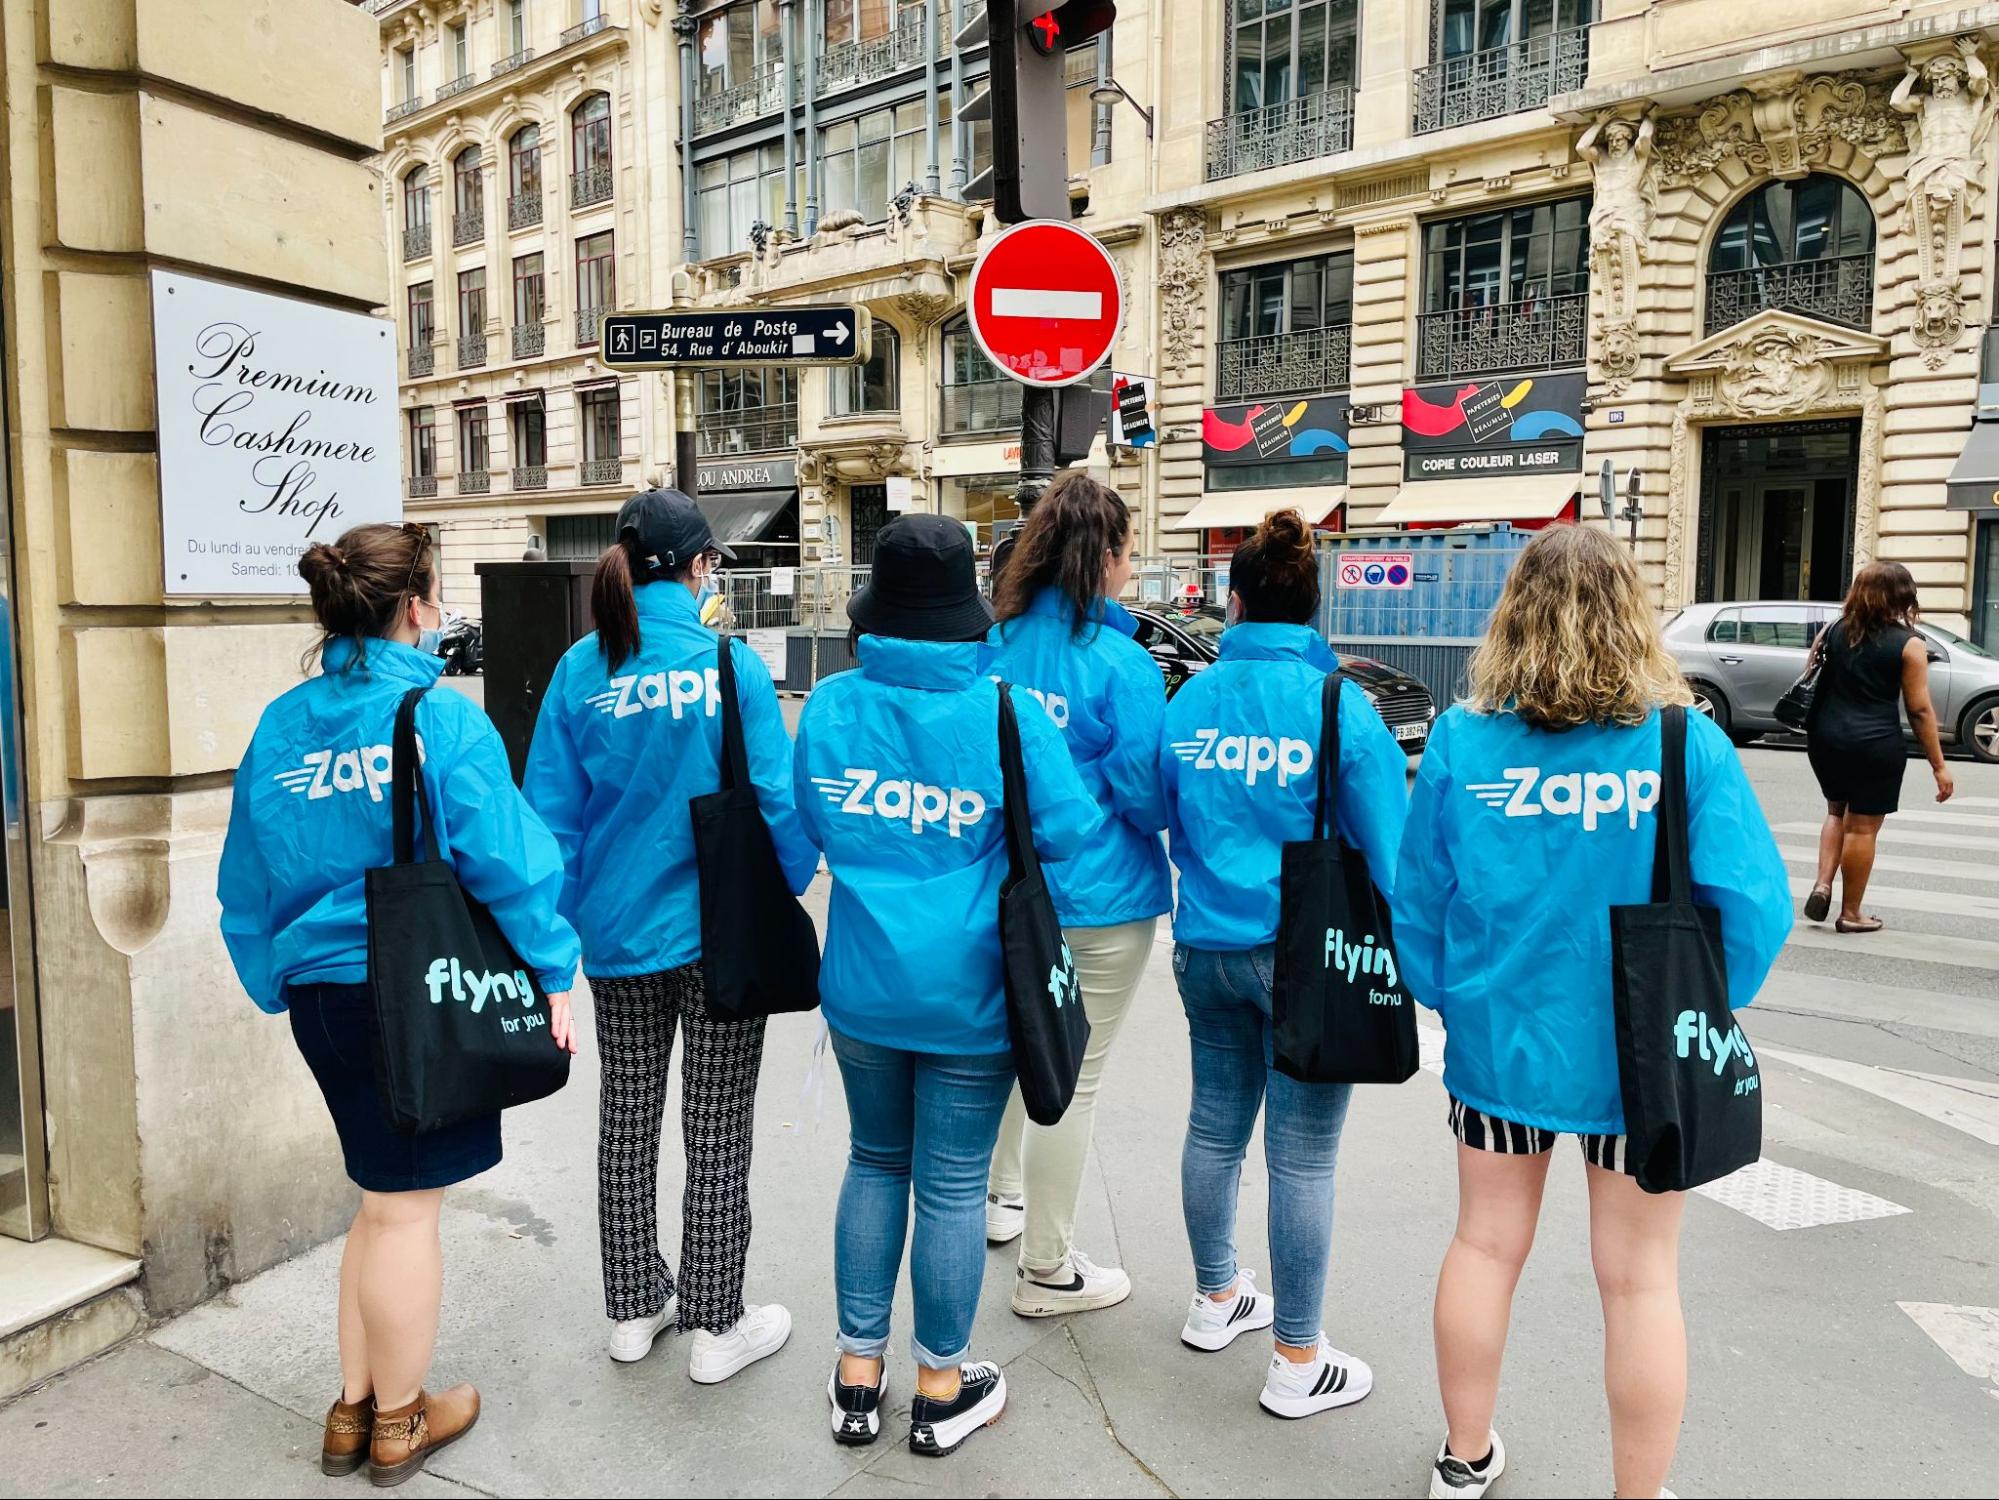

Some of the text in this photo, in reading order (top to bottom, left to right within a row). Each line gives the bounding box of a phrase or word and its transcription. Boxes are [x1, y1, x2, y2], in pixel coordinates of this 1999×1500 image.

[661, 319, 798, 340] Bureau de Poste
[689, 341, 713, 357] Rue
[189, 322, 377, 404] Premium
[1467, 393, 1501, 416] PAPETERIES
[192, 382, 377, 463] Cashmere
[1422, 451, 1560, 471] COPIE COULEUR LASER
[697, 467, 772, 487] OU ANDREA
[240, 455, 344, 538] Shop
[188, 539, 305, 557] Du lundi au vendre
[231, 562, 281, 577] Samedi:
[1195, 728, 1314, 788] Zapp
[842, 768, 986, 838] Zapp
[1503, 766, 1662, 832] Zapp
[501, 1012, 546, 1033] for you
[1745, 1074, 1758, 1096] you
